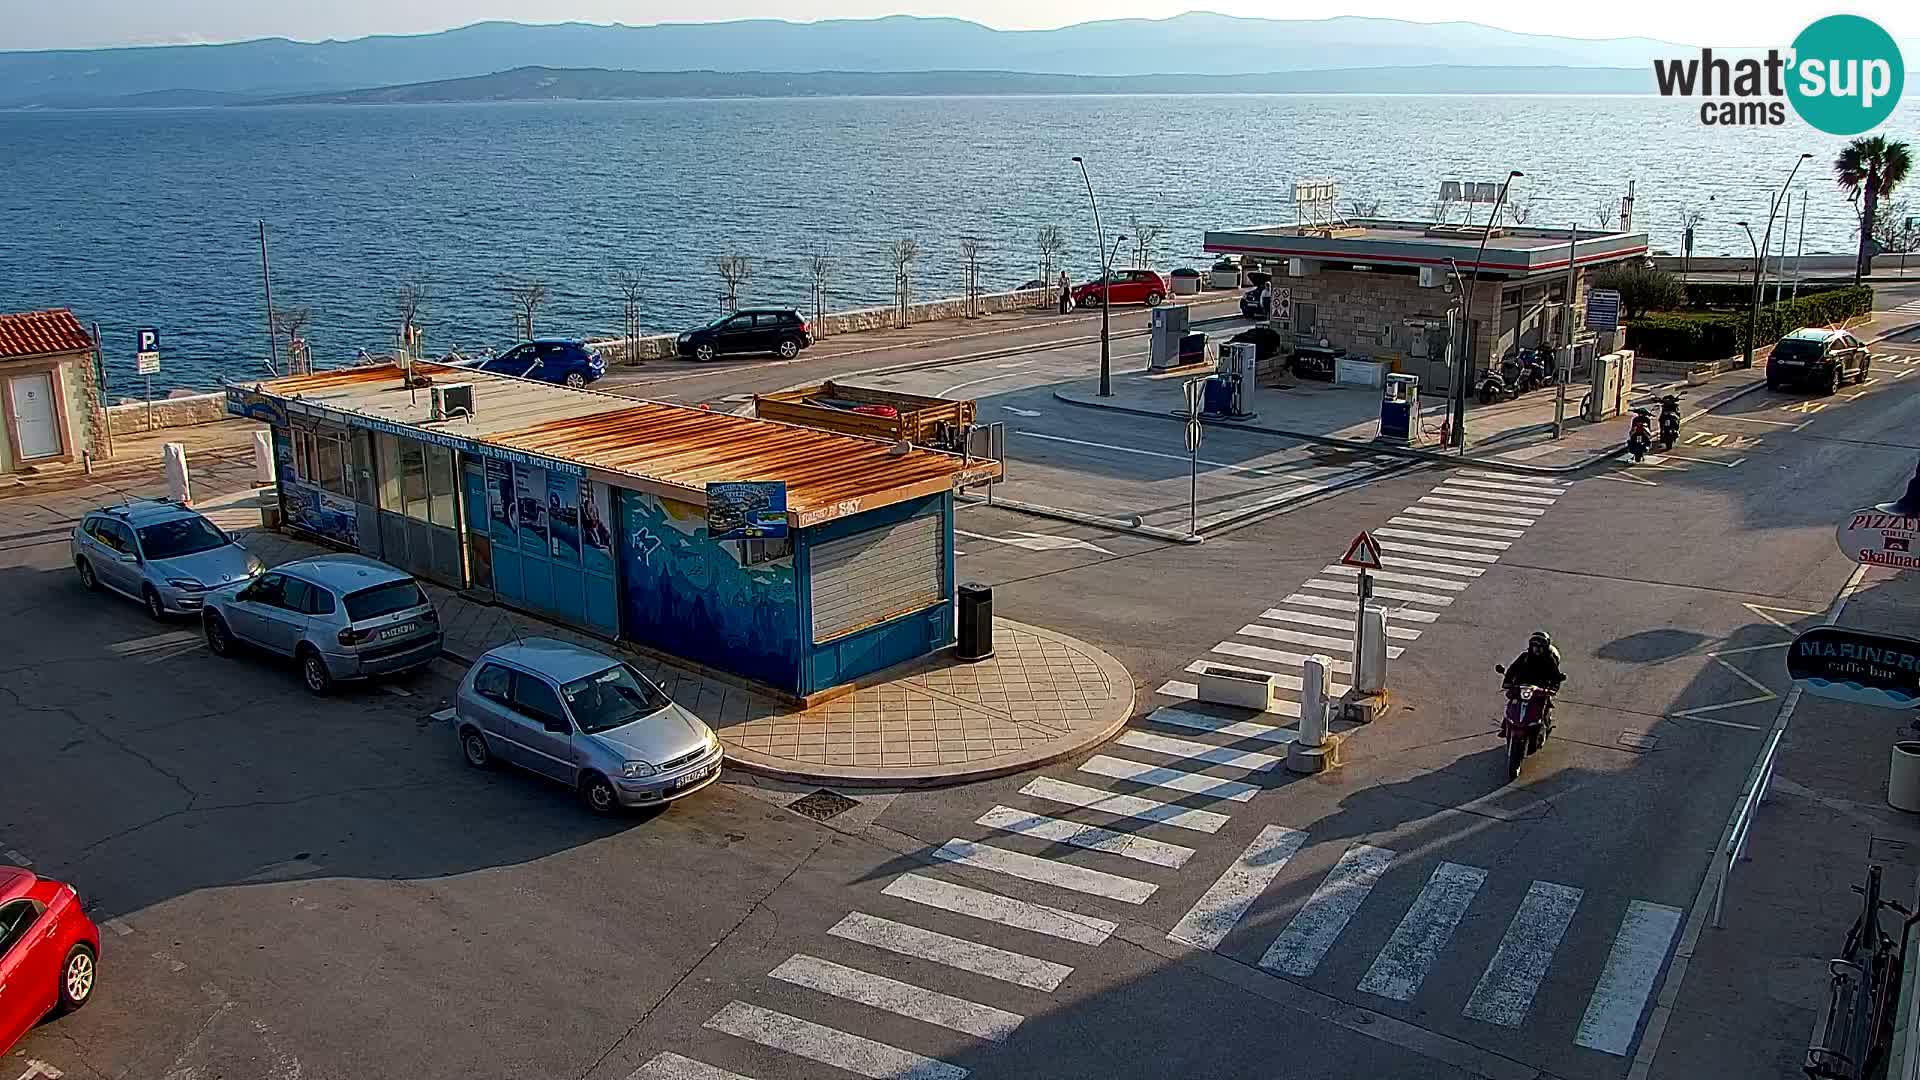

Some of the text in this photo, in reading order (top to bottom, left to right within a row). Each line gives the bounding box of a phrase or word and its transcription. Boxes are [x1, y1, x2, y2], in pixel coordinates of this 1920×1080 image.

[142, 332, 155, 350] P
[437, 436, 469, 450] POSTAJA
[479, 445, 494, 457] BUS
[494, 448, 526, 464] STATION
[528, 456, 555, 470] TICKET
[557, 462, 583, 476] OFFICE
[838, 498, 862, 516] SKY
[1870, 664, 1897, 679] bar
